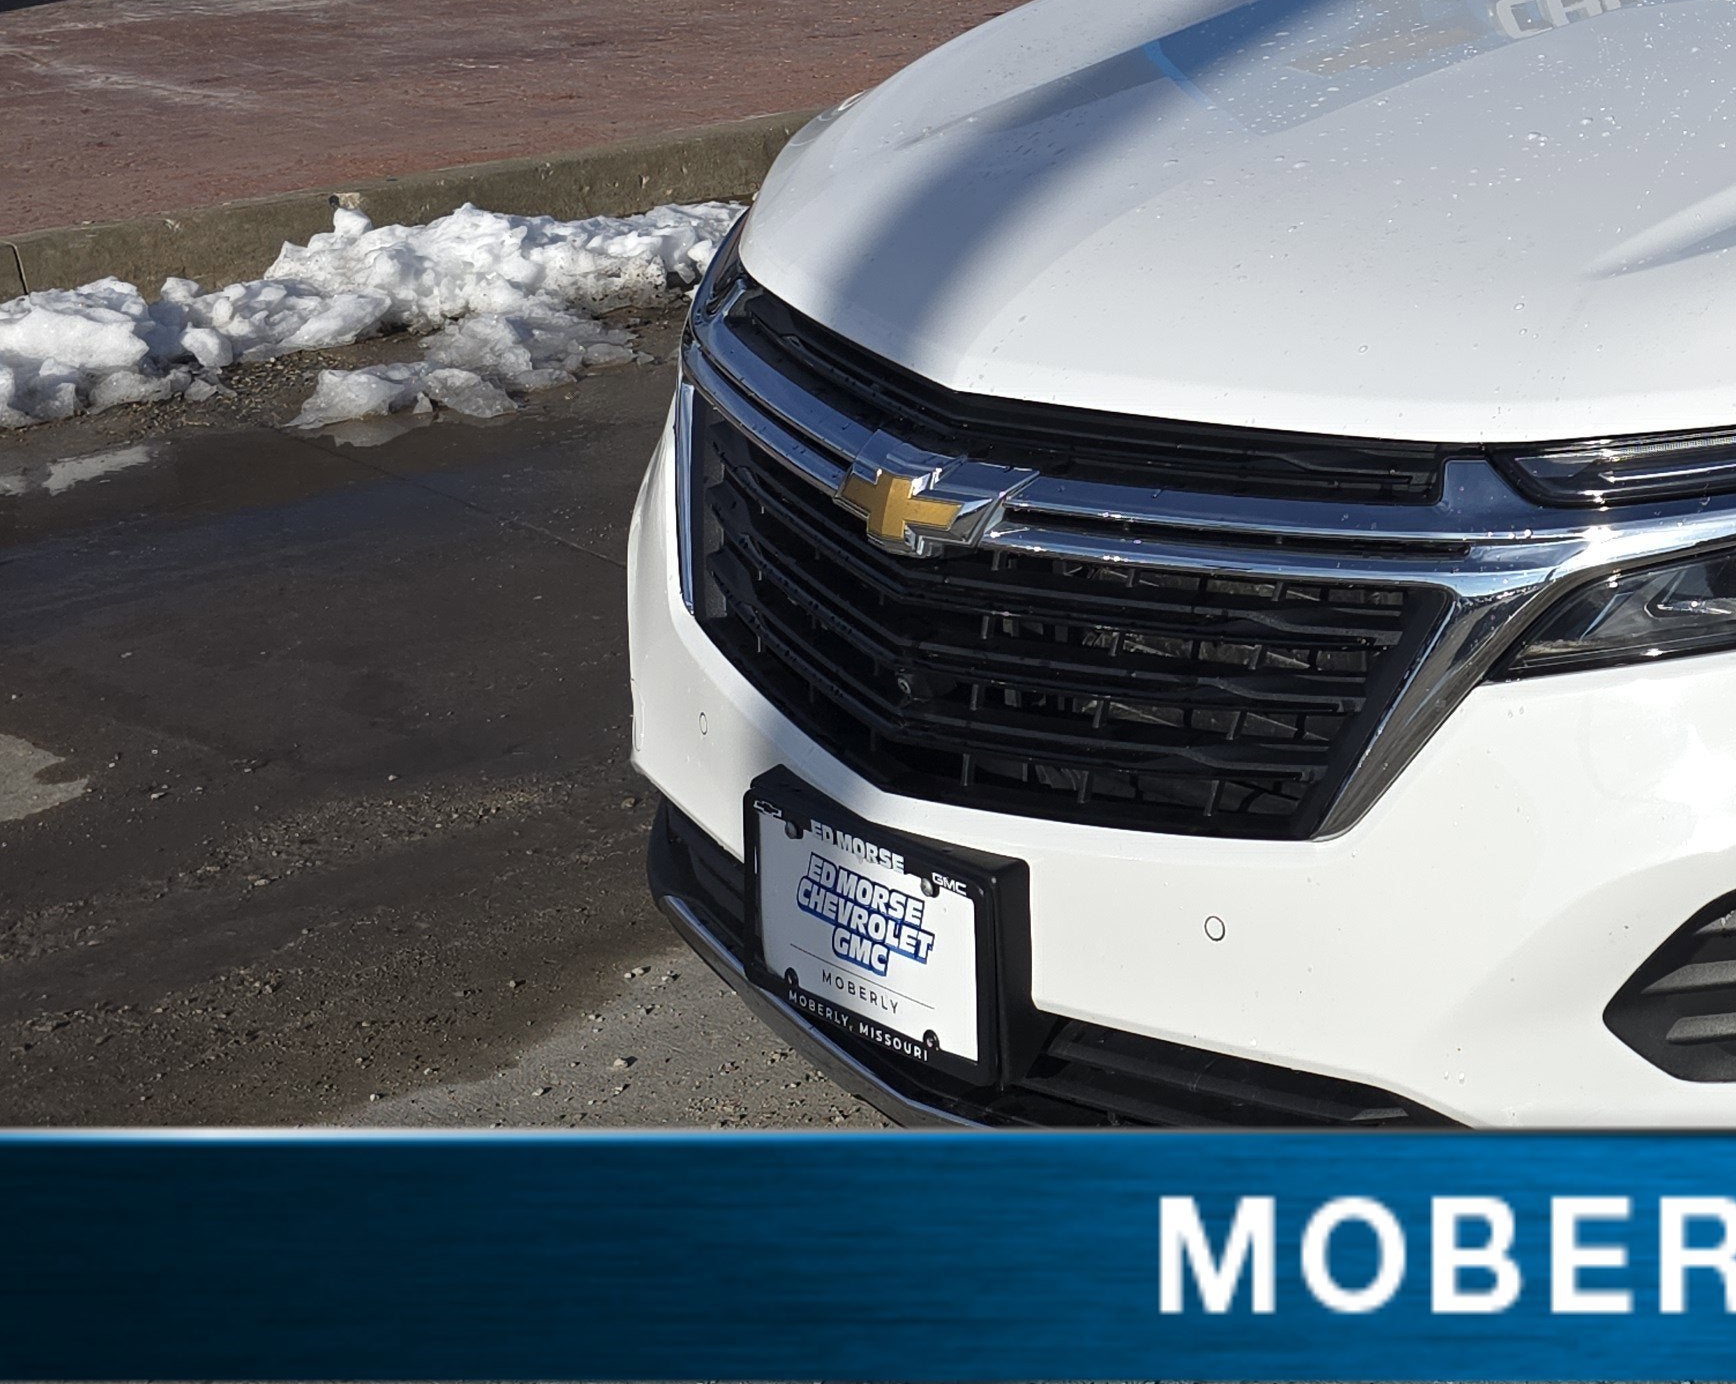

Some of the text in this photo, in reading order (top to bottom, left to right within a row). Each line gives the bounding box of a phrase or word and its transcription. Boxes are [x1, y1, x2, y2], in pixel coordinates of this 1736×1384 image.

[810, 819, 905, 875] ED MORSE
[808, 852, 925, 928] ED MORSE
[931, 872, 967, 896] GMC
[797, 875, 935, 963] CHEVROLET
[832, 926, 891, 976] GMC
[822, 969, 899, 1015] MOBERLY
[788, 989, 929, 1062] MOBERLY, MISSOURI
